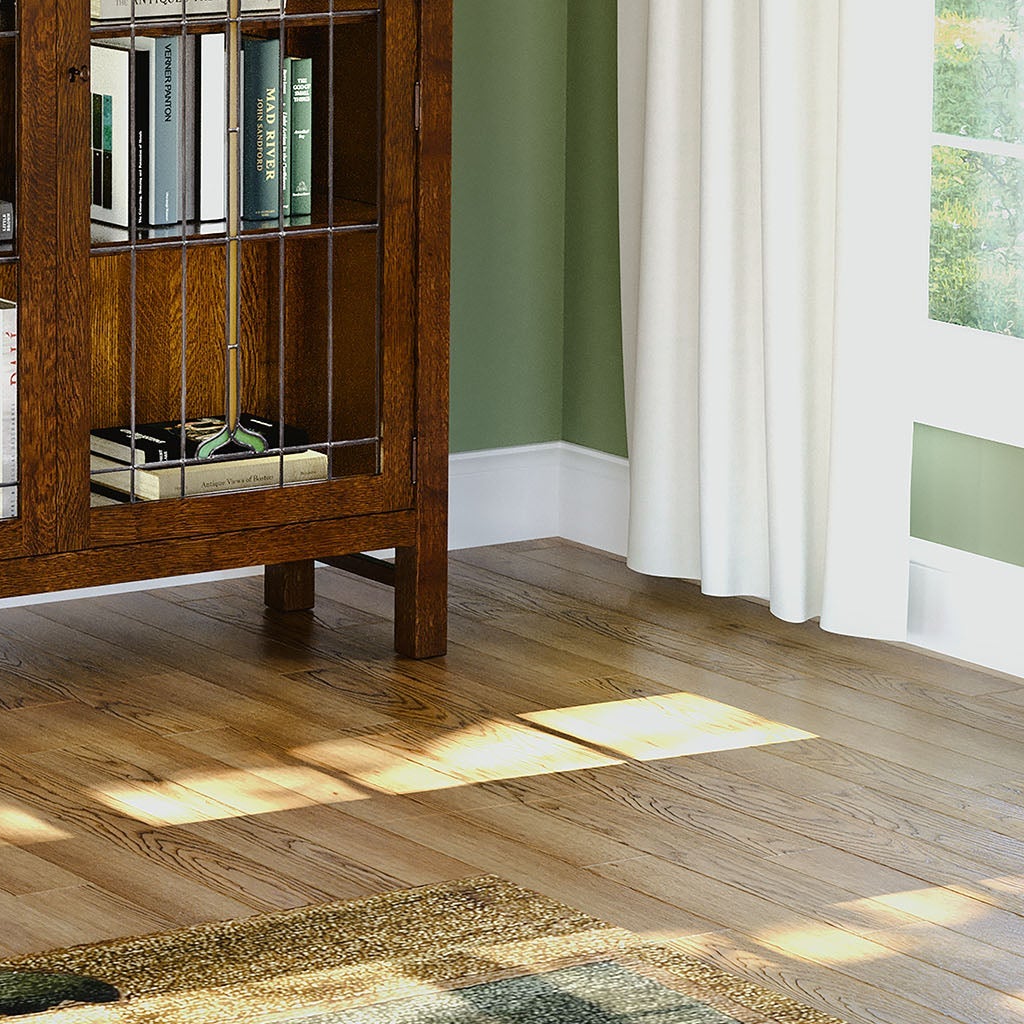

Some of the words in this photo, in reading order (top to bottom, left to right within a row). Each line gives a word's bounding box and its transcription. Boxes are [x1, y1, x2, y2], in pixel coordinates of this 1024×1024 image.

[164, 43, 172, 83] VERNER
[164, 84, 172, 122] PANTON
[266, 87, 276, 124] MAD
[265, 130, 276, 181] RIVER
[201, 481, 225, 489] Antique
[245, 475, 252, 483] of
